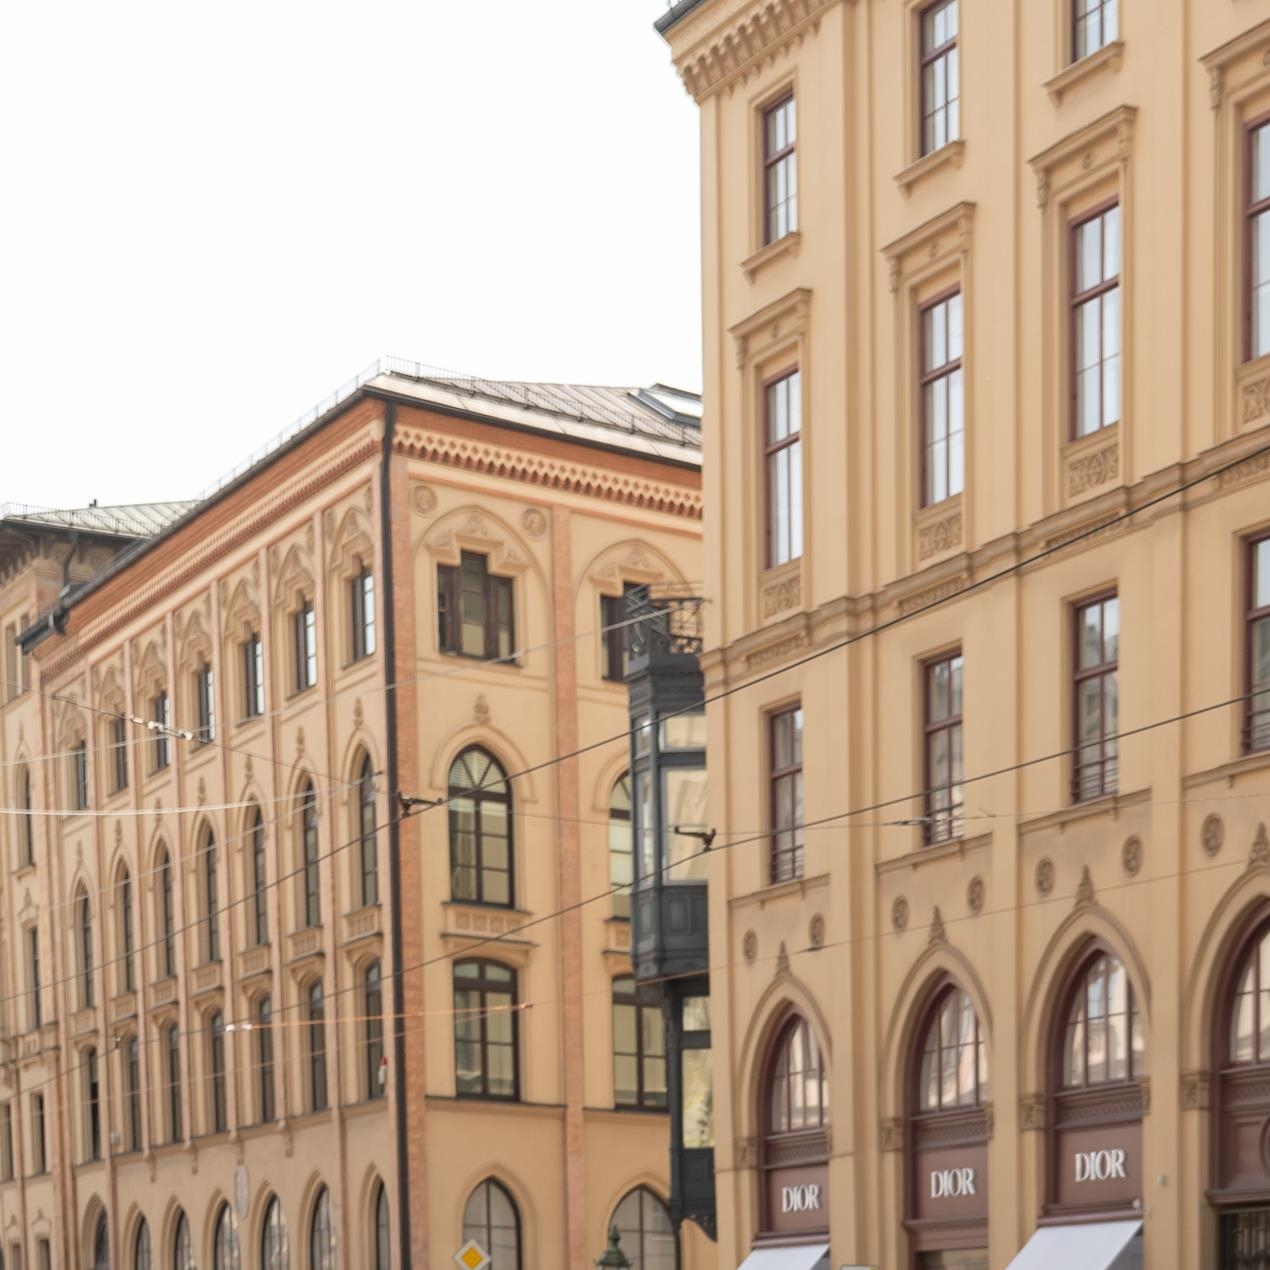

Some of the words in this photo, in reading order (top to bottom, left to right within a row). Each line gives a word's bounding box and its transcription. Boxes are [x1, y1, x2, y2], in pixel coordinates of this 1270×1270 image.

[1075, 1149, 1125, 1182] DIOR
[782, 1184, 820, 1212] DIOR
[931, 1168, 975, 1198] DIOR
